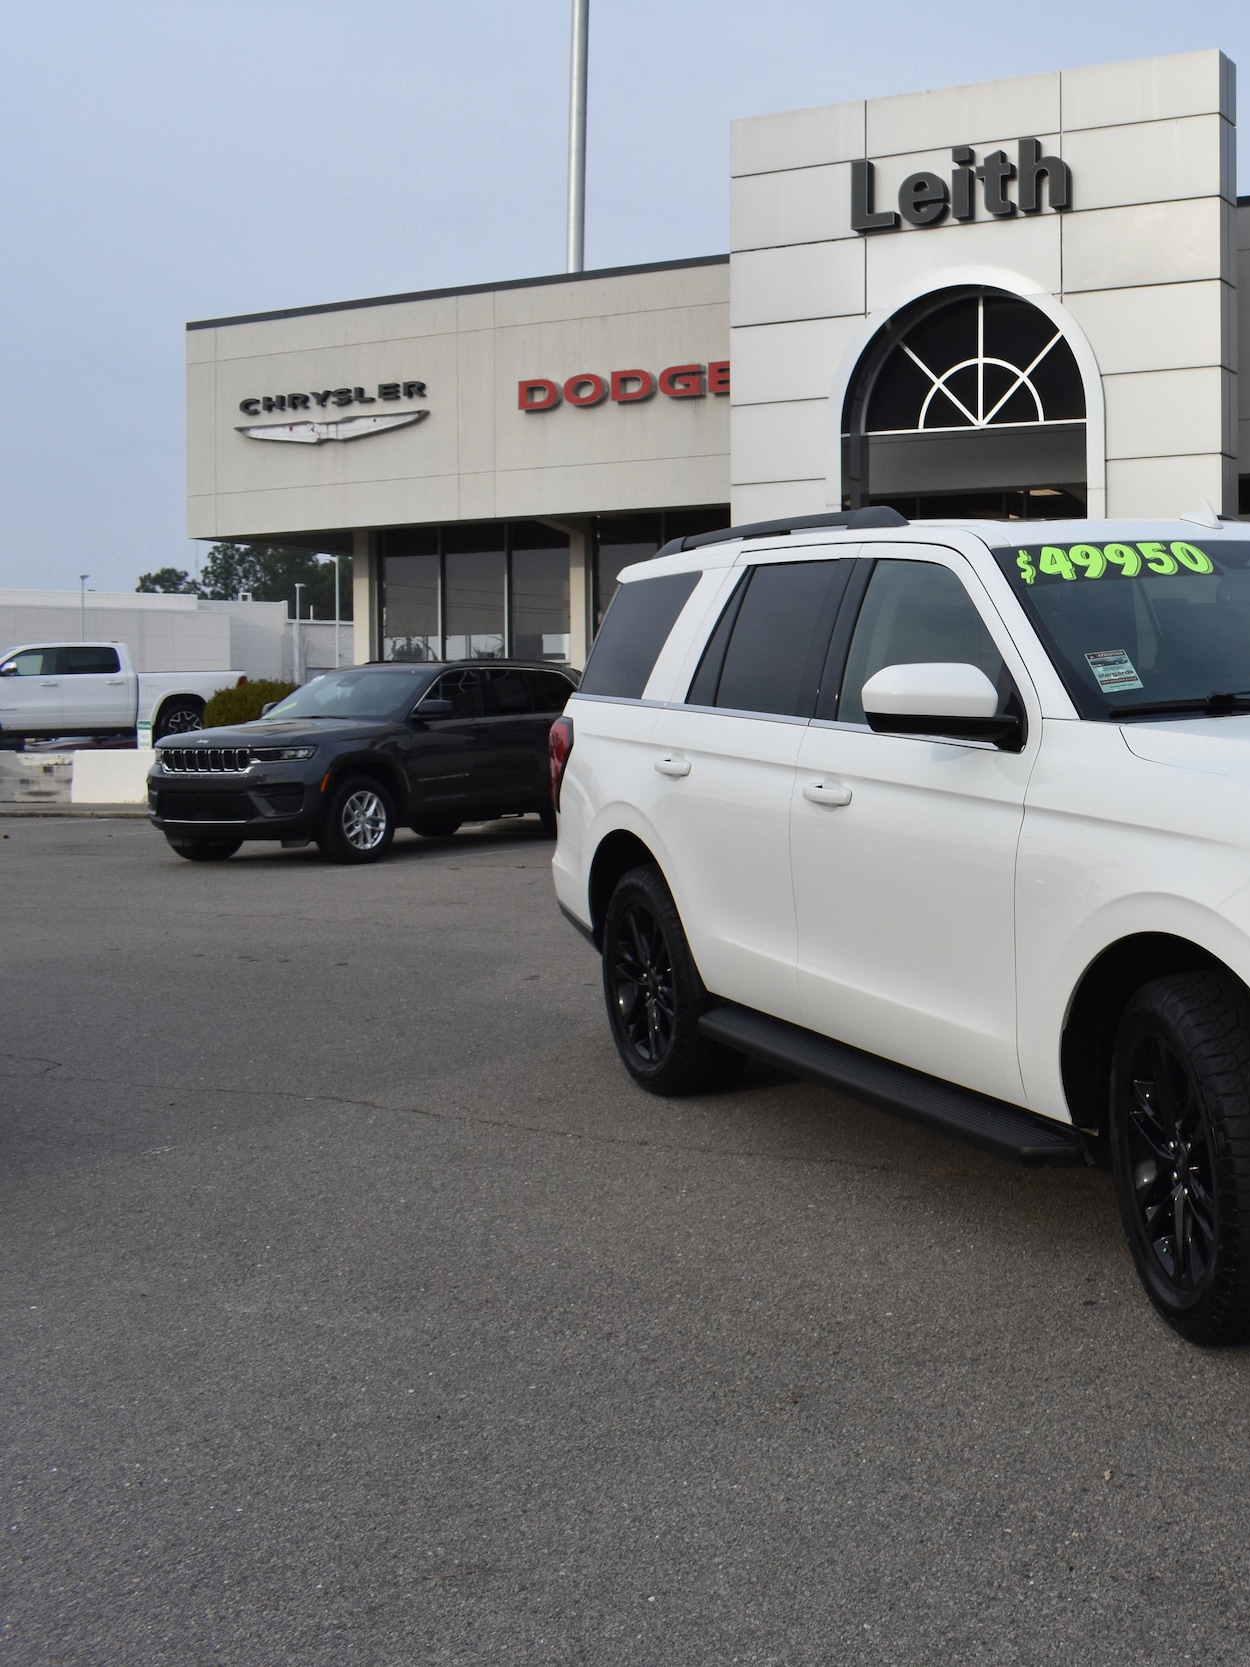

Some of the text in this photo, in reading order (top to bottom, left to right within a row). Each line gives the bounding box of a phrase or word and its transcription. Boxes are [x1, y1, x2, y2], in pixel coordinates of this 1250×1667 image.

[850, 137, 1072, 235] Leith
[239, 380, 427, 416] CHRYSLER
[518, 361, 730, 413] DODGE
[1016, 541, 1214, 585] $49950
